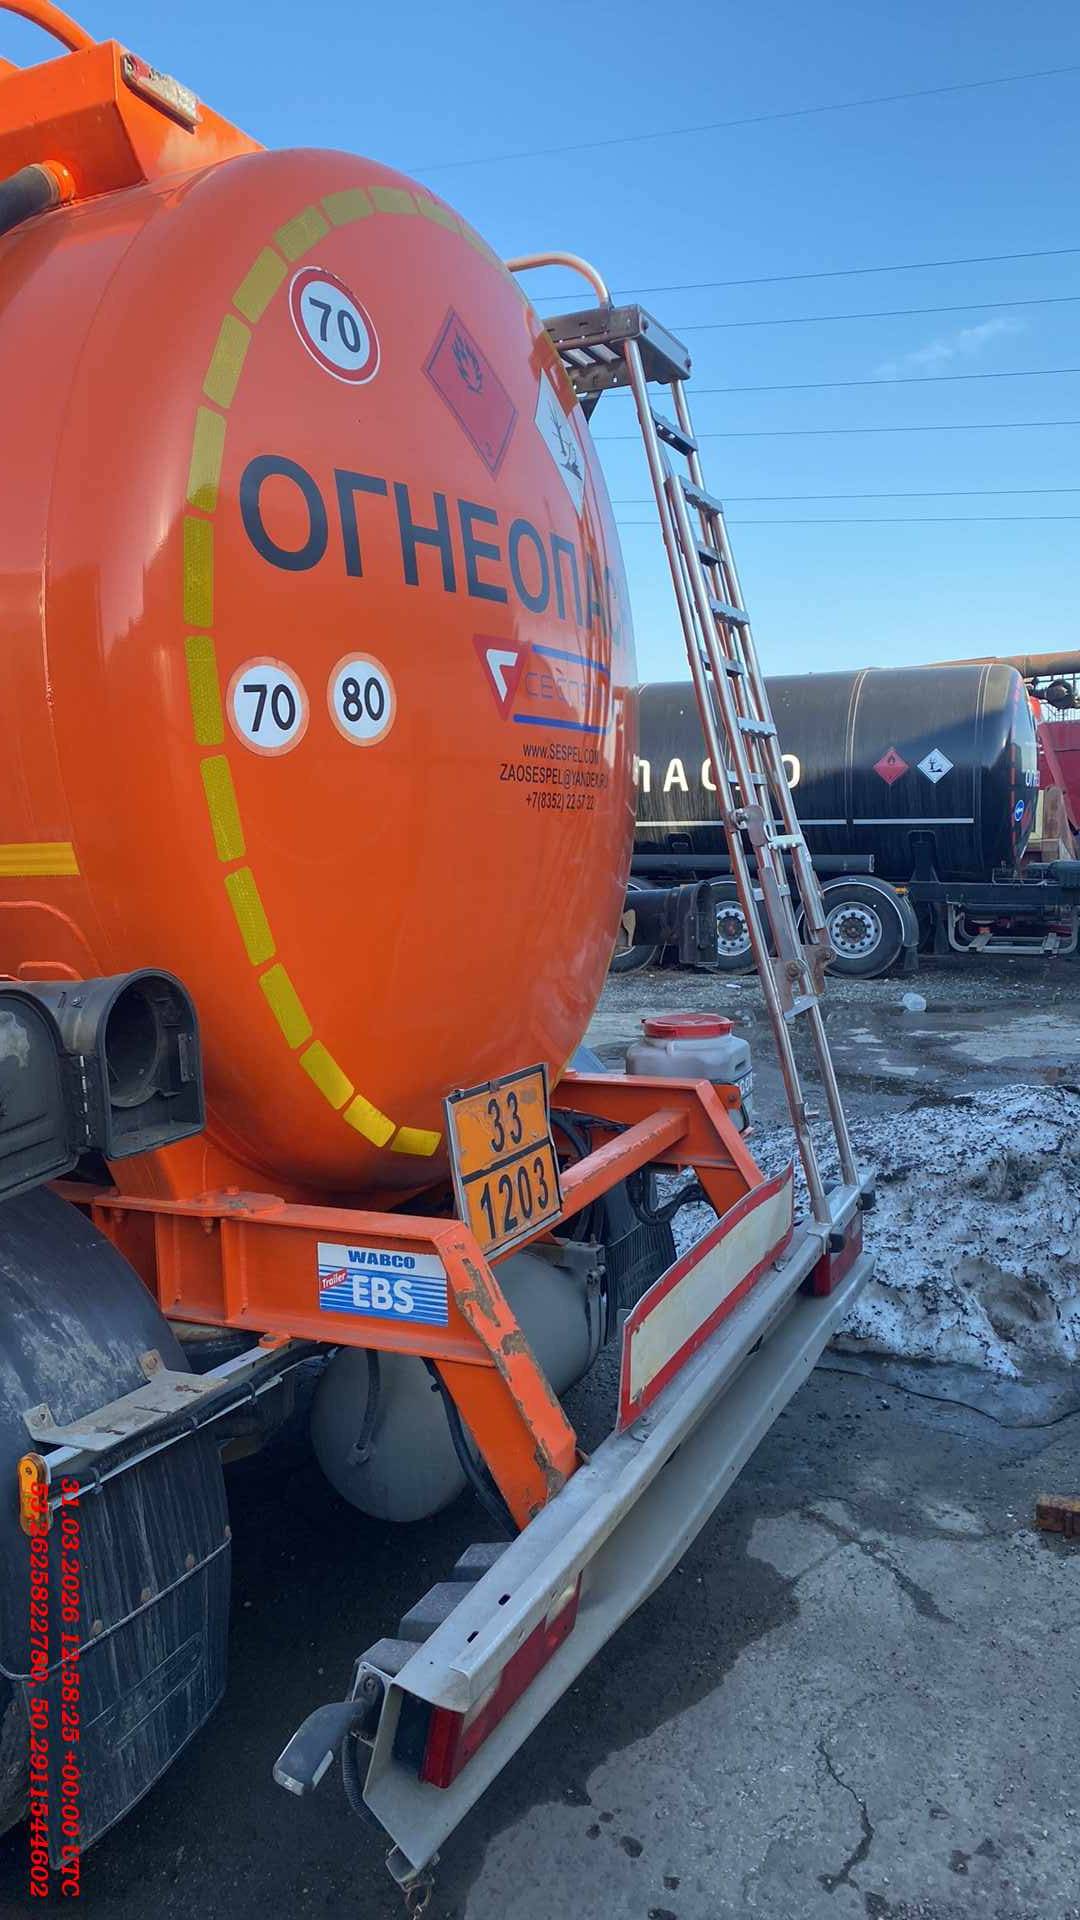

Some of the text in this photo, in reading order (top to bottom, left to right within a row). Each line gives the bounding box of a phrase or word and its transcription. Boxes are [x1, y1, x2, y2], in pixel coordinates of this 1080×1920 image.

[309, 296, 361, 354] 70
[242, 683, 297, 732] 70
[341, 676, 386, 722] 80
[487, 1091, 523, 1153] 33
[479, 1156, 549, 1240] 1203
[321, 1271, 347, 1290] Trailer
[347, 1249, 416, 1270] WABCO
[351, 1274, 415, 1315] EBS
